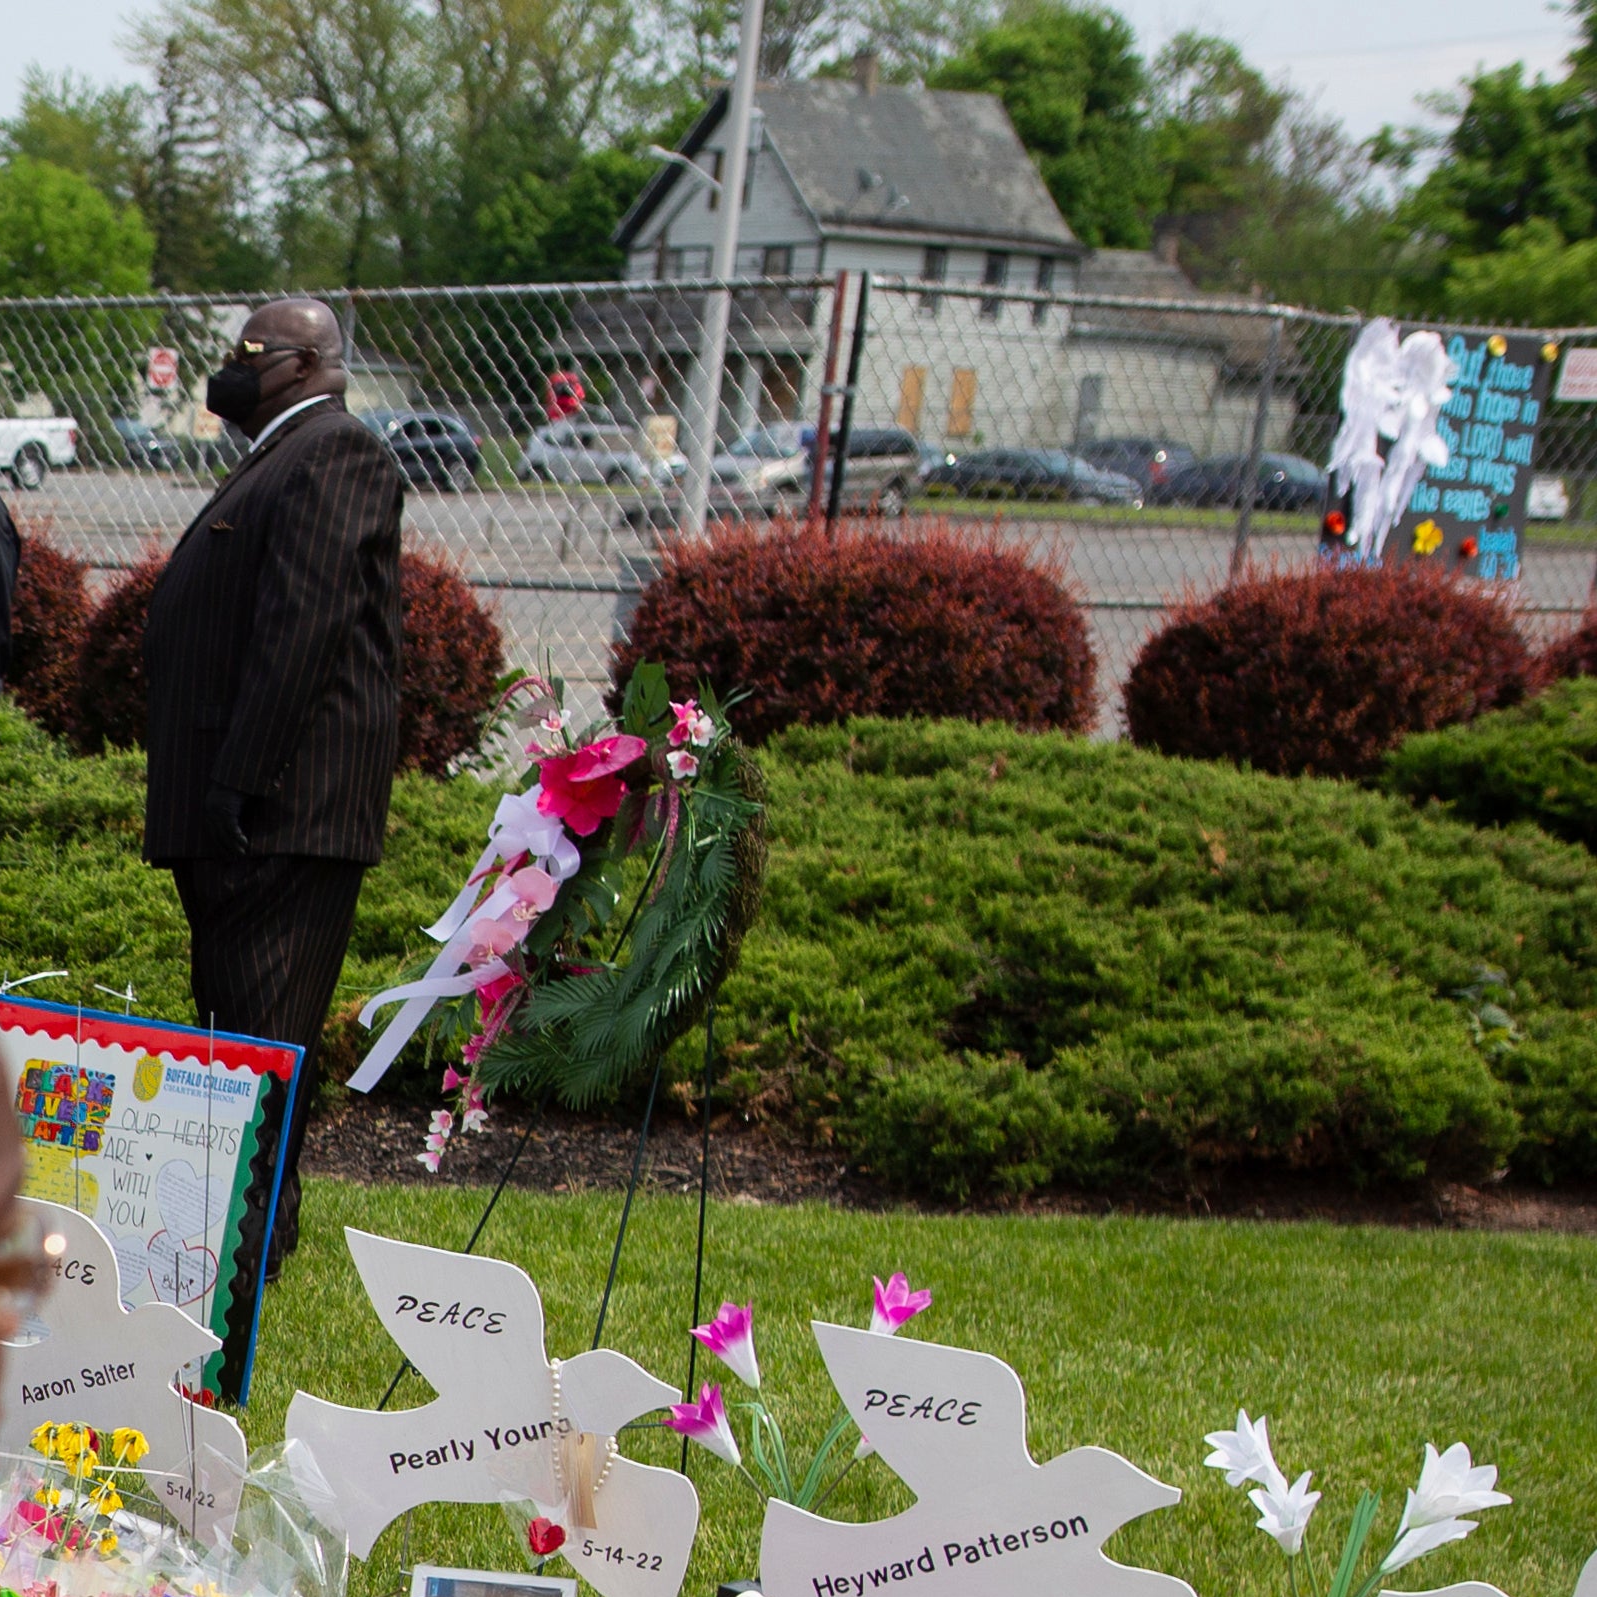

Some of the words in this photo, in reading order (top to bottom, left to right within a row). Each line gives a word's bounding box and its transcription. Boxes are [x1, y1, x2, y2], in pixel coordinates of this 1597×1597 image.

[1461, 421, 1504, 460] LORD
[1409, 481, 1440, 513] like
[26, 1066, 105, 1105] BLACK
[165, 1067, 202, 1088] BUFFALO
[202, 1074, 252, 1097] COLLEGIATE
[21, 1091, 88, 1124] LIVES
[121, 1107, 161, 1138] OUR
[172, 1118, 241, 1156] HEARTS
[103, 1135, 139, 1166] ARE
[112, 1167, 151, 1199] WITH
[106, 1196, 146, 1229] YOU
[394, 1294, 507, 1334] PEACE
[21, 1373, 77, 1405] Aaron
[80, 1361, 137, 1388] Salter
[864, 1389, 983, 1427] PEACE
[389, 1437, 476, 1475] Pearly
[165, 1479, 217, 1510] 5-14-22
[581, 1538, 664, 1572] 5-14-22
[944, 1514, 1090, 1568] Patterson
